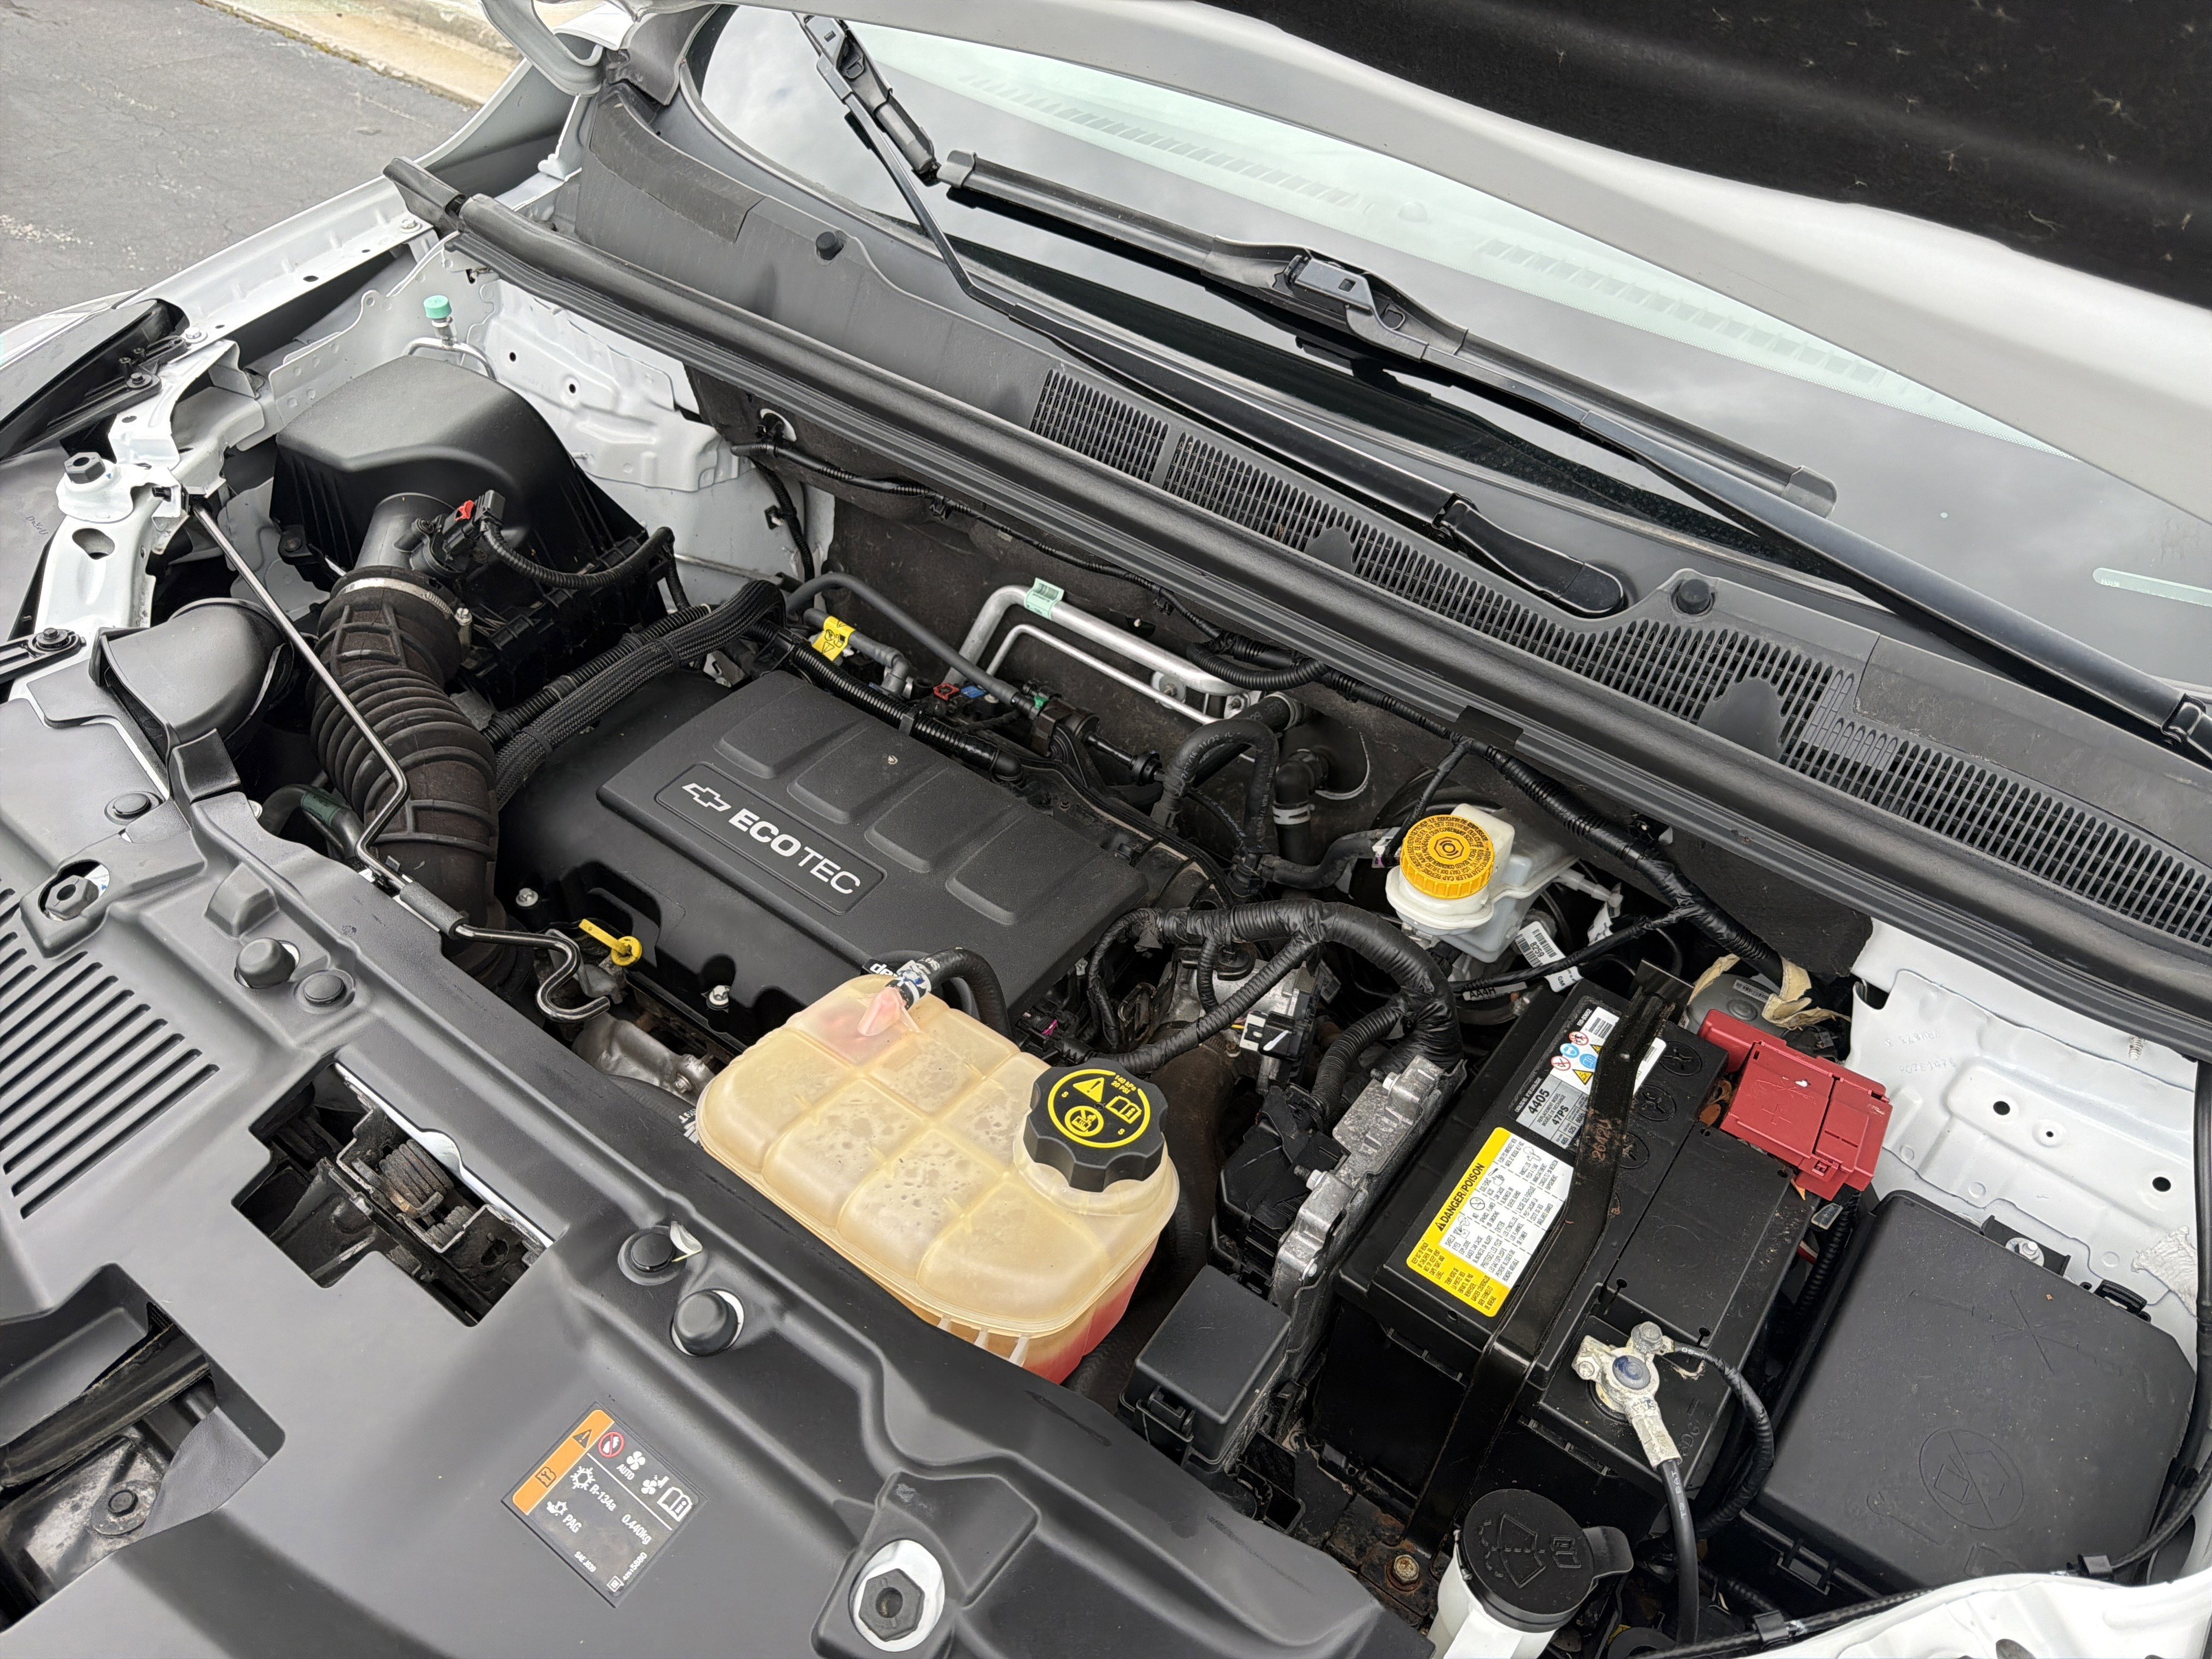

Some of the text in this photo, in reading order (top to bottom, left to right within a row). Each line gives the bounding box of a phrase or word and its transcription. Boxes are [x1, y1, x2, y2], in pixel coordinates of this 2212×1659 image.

[729, 809, 861, 895] ECOTEC
[1530, 941, 1545, 957] 8259
[1557, 976, 1565, 986] GM
[1114, 1075, 1125, 1085] 140
[1119, 1085, 1131, 1094] PSI
[1528, 1088, 1550, 1115] 4405
[1550, 1104, 1569, 1126] 47PS
[1567, 1125, 1577, 1135] 525
[1441, 1163, 1486, 1224] DANGER/POISON
[616, 1463, 635, 1481] AUTO
[589, 1483, 617, 1512] R-134a
[562, 1513, 582, 1533] PAG
[622, 1513, 652, 1545] 0.440kg
[574, 1551, 597, 1572] SAE J639
